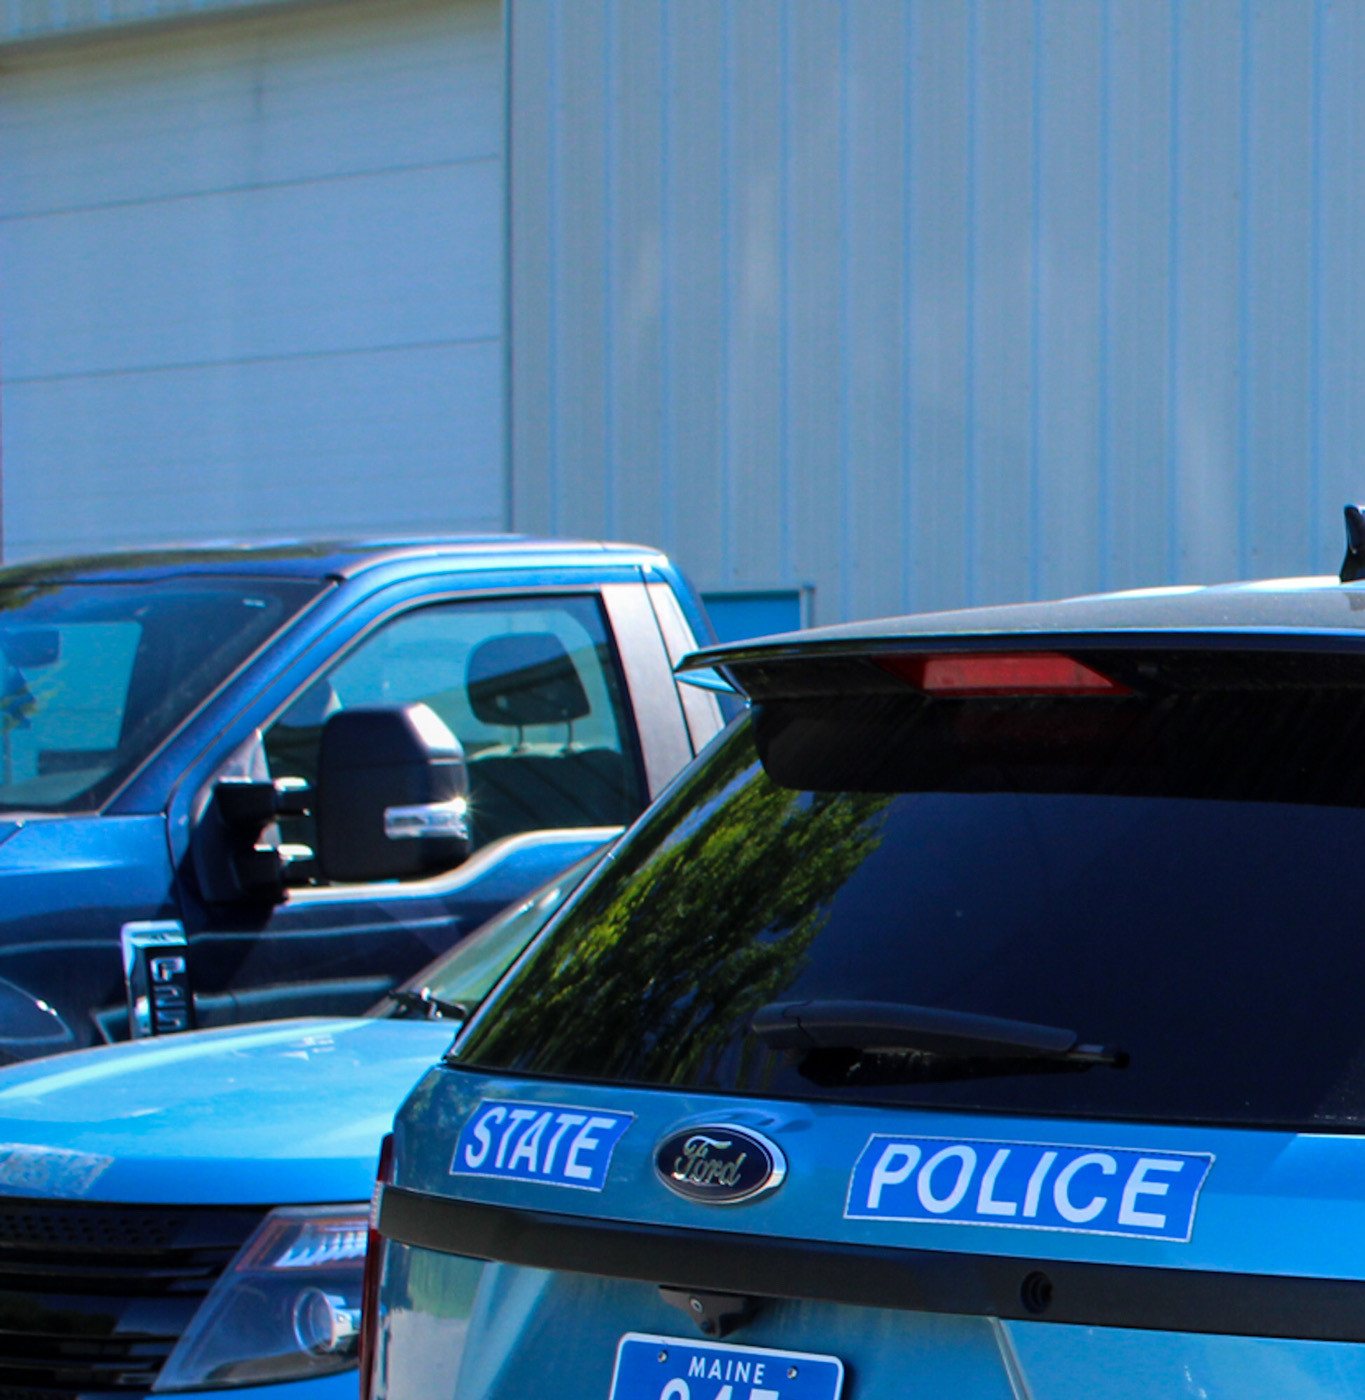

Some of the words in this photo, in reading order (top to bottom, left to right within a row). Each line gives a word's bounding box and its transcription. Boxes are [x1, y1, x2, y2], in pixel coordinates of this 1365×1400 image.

[464, 1106, 617, 1180] STATE
[866, 1143, 1185, 1229] POLICE
[671, 1135, 747, 1187] Ford
[687, 1356, 766, 1385] MAINE
